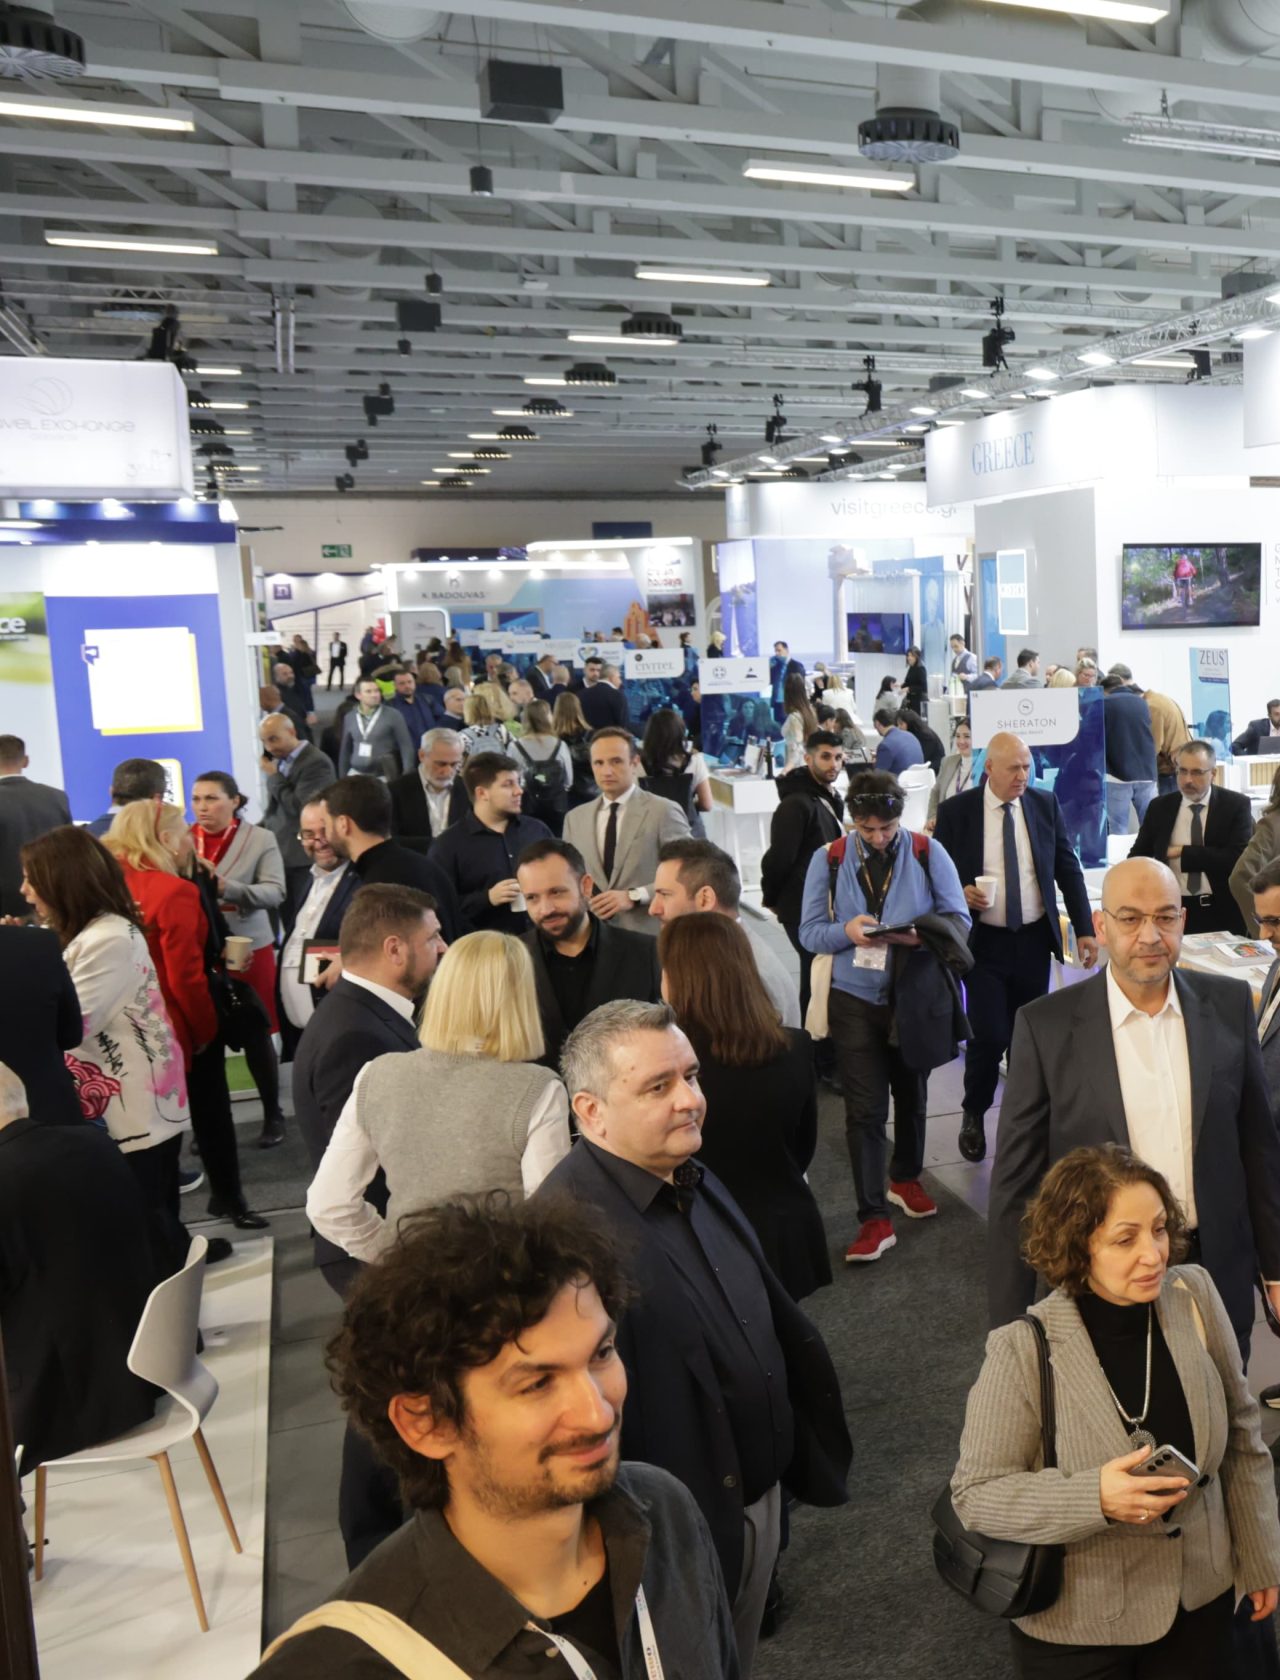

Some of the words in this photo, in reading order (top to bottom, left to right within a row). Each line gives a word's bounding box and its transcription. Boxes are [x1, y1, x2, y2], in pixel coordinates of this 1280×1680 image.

[972, 431, 1035, 476] GREECE
[1199, 649, 1225, 666] ZEUS
[997, 718, 1057, 729] SHERATON
